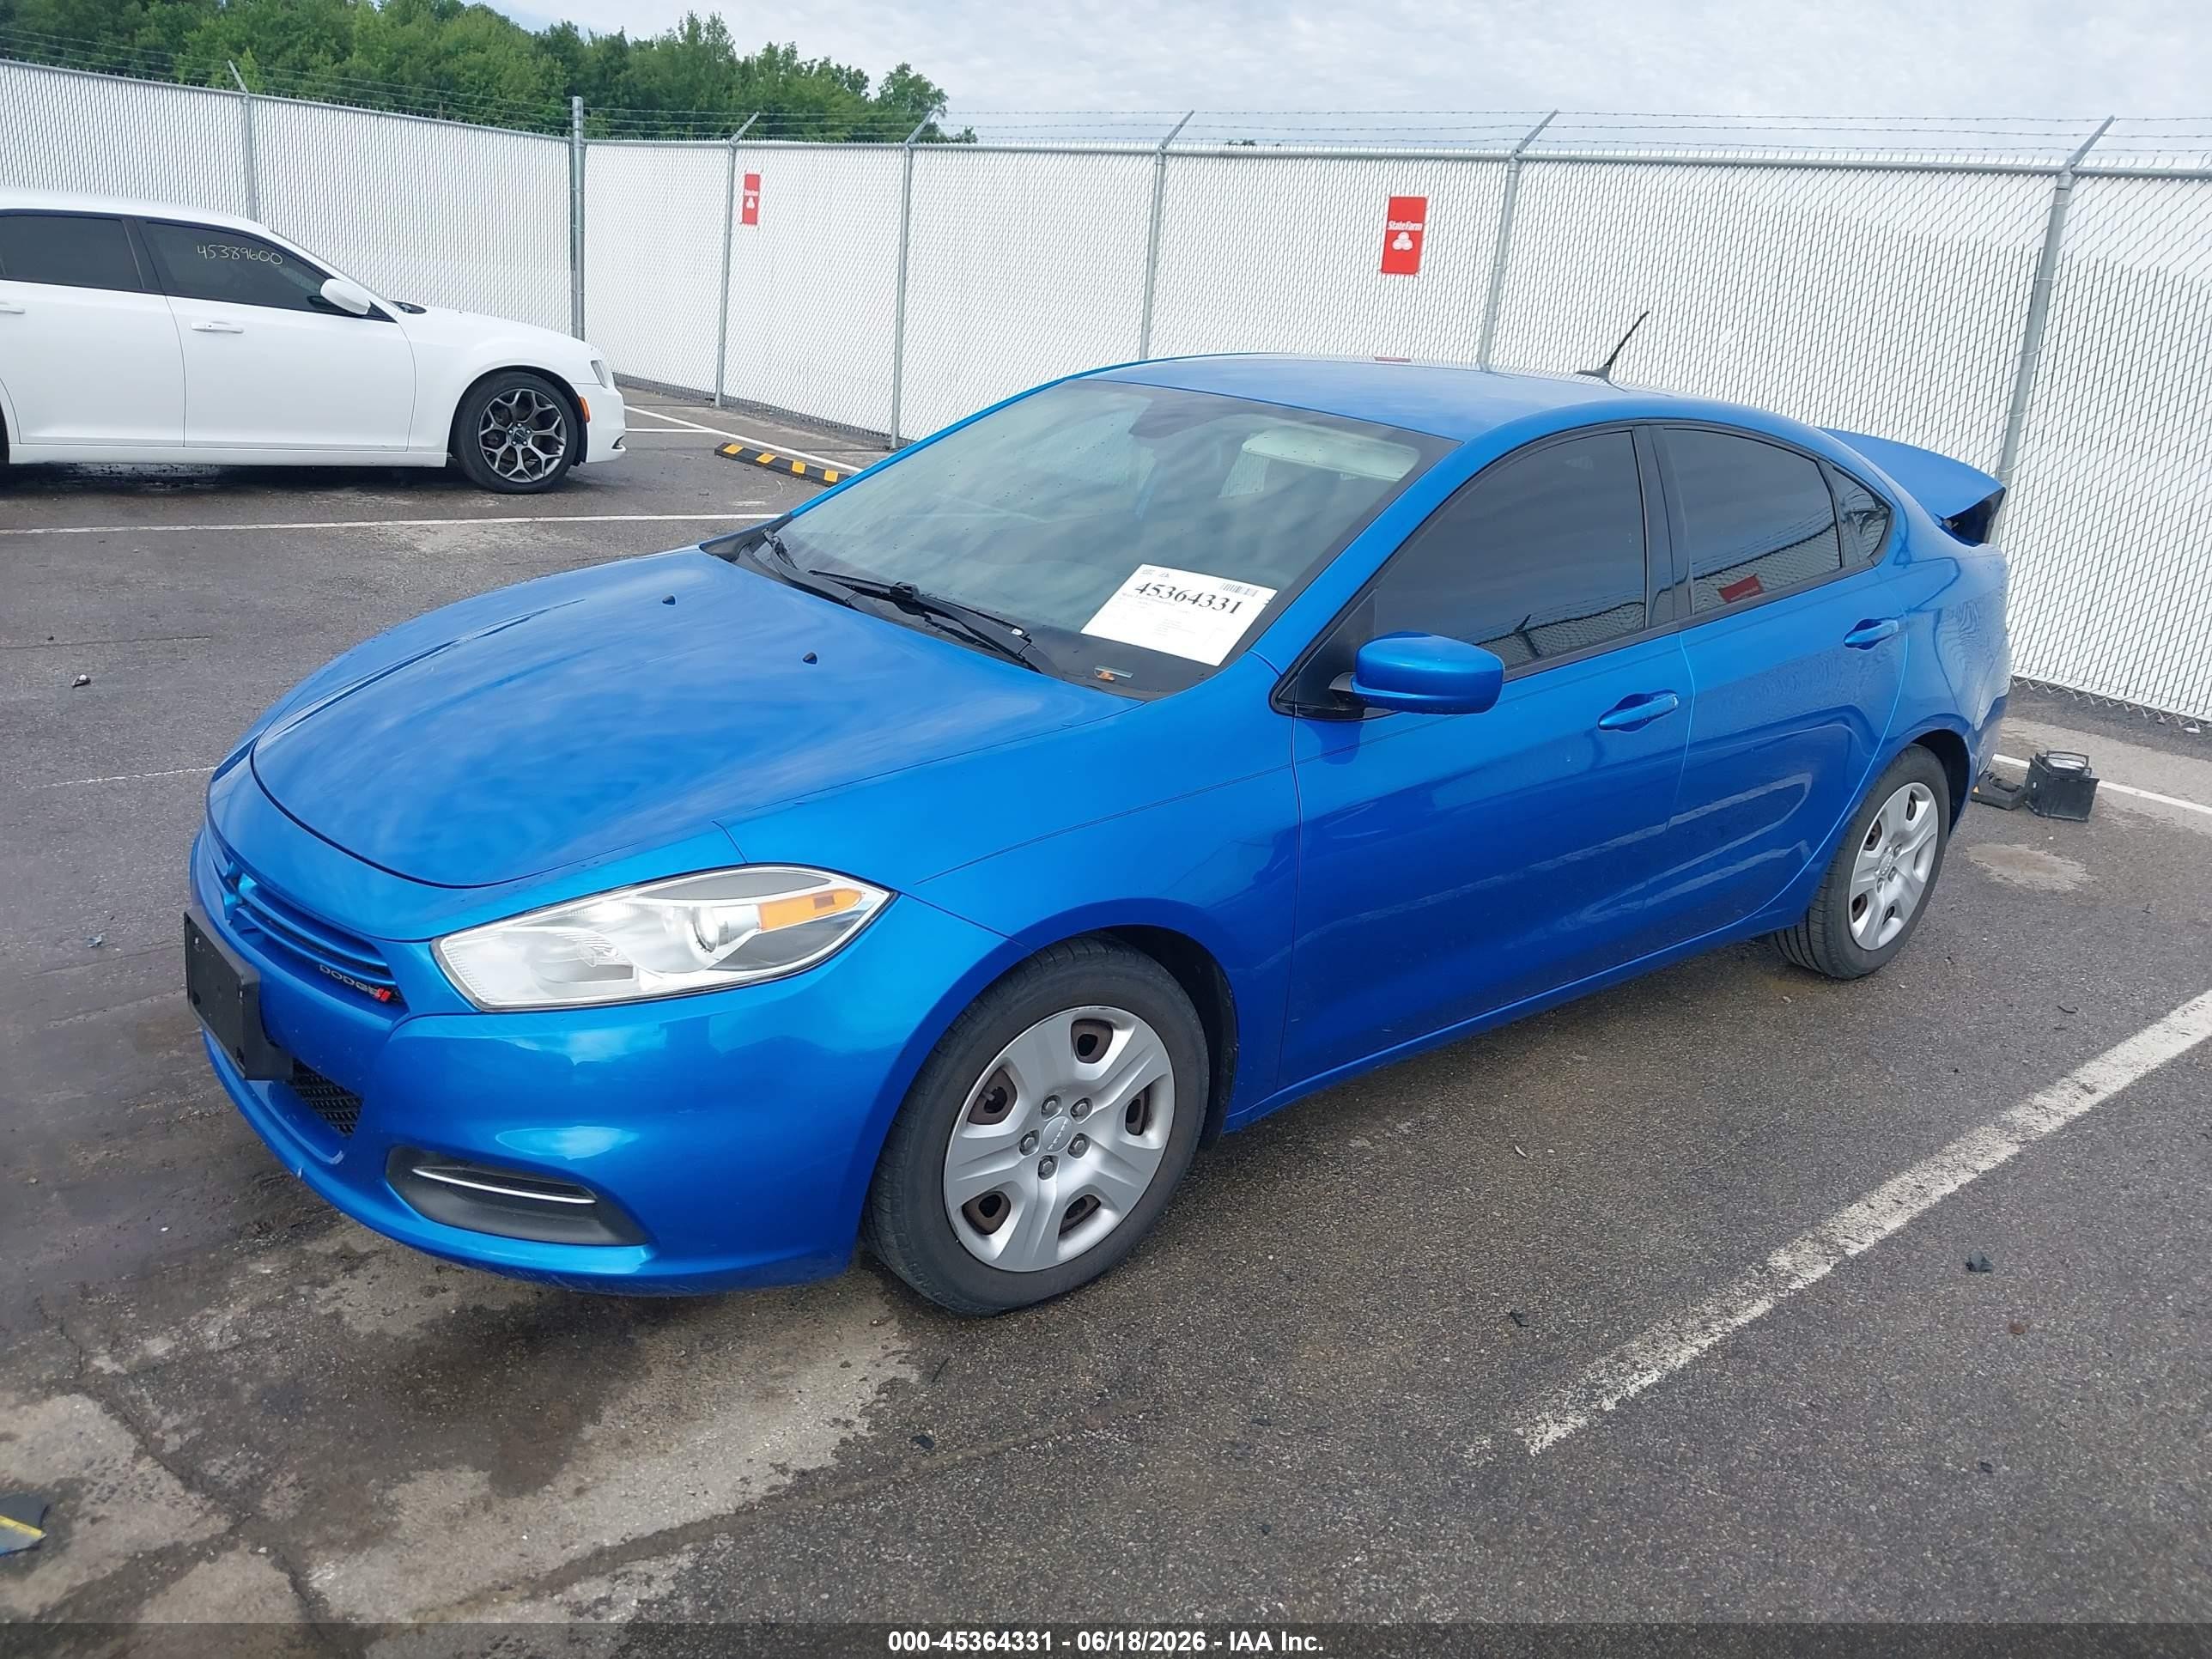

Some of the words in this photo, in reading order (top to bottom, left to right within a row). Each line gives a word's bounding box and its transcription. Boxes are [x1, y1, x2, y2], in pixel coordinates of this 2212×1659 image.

[197, 245, 283, 265] 45389600
[1134, 581, 1243, 615] 45364331
[319, 964, 379, 995] DODGE
